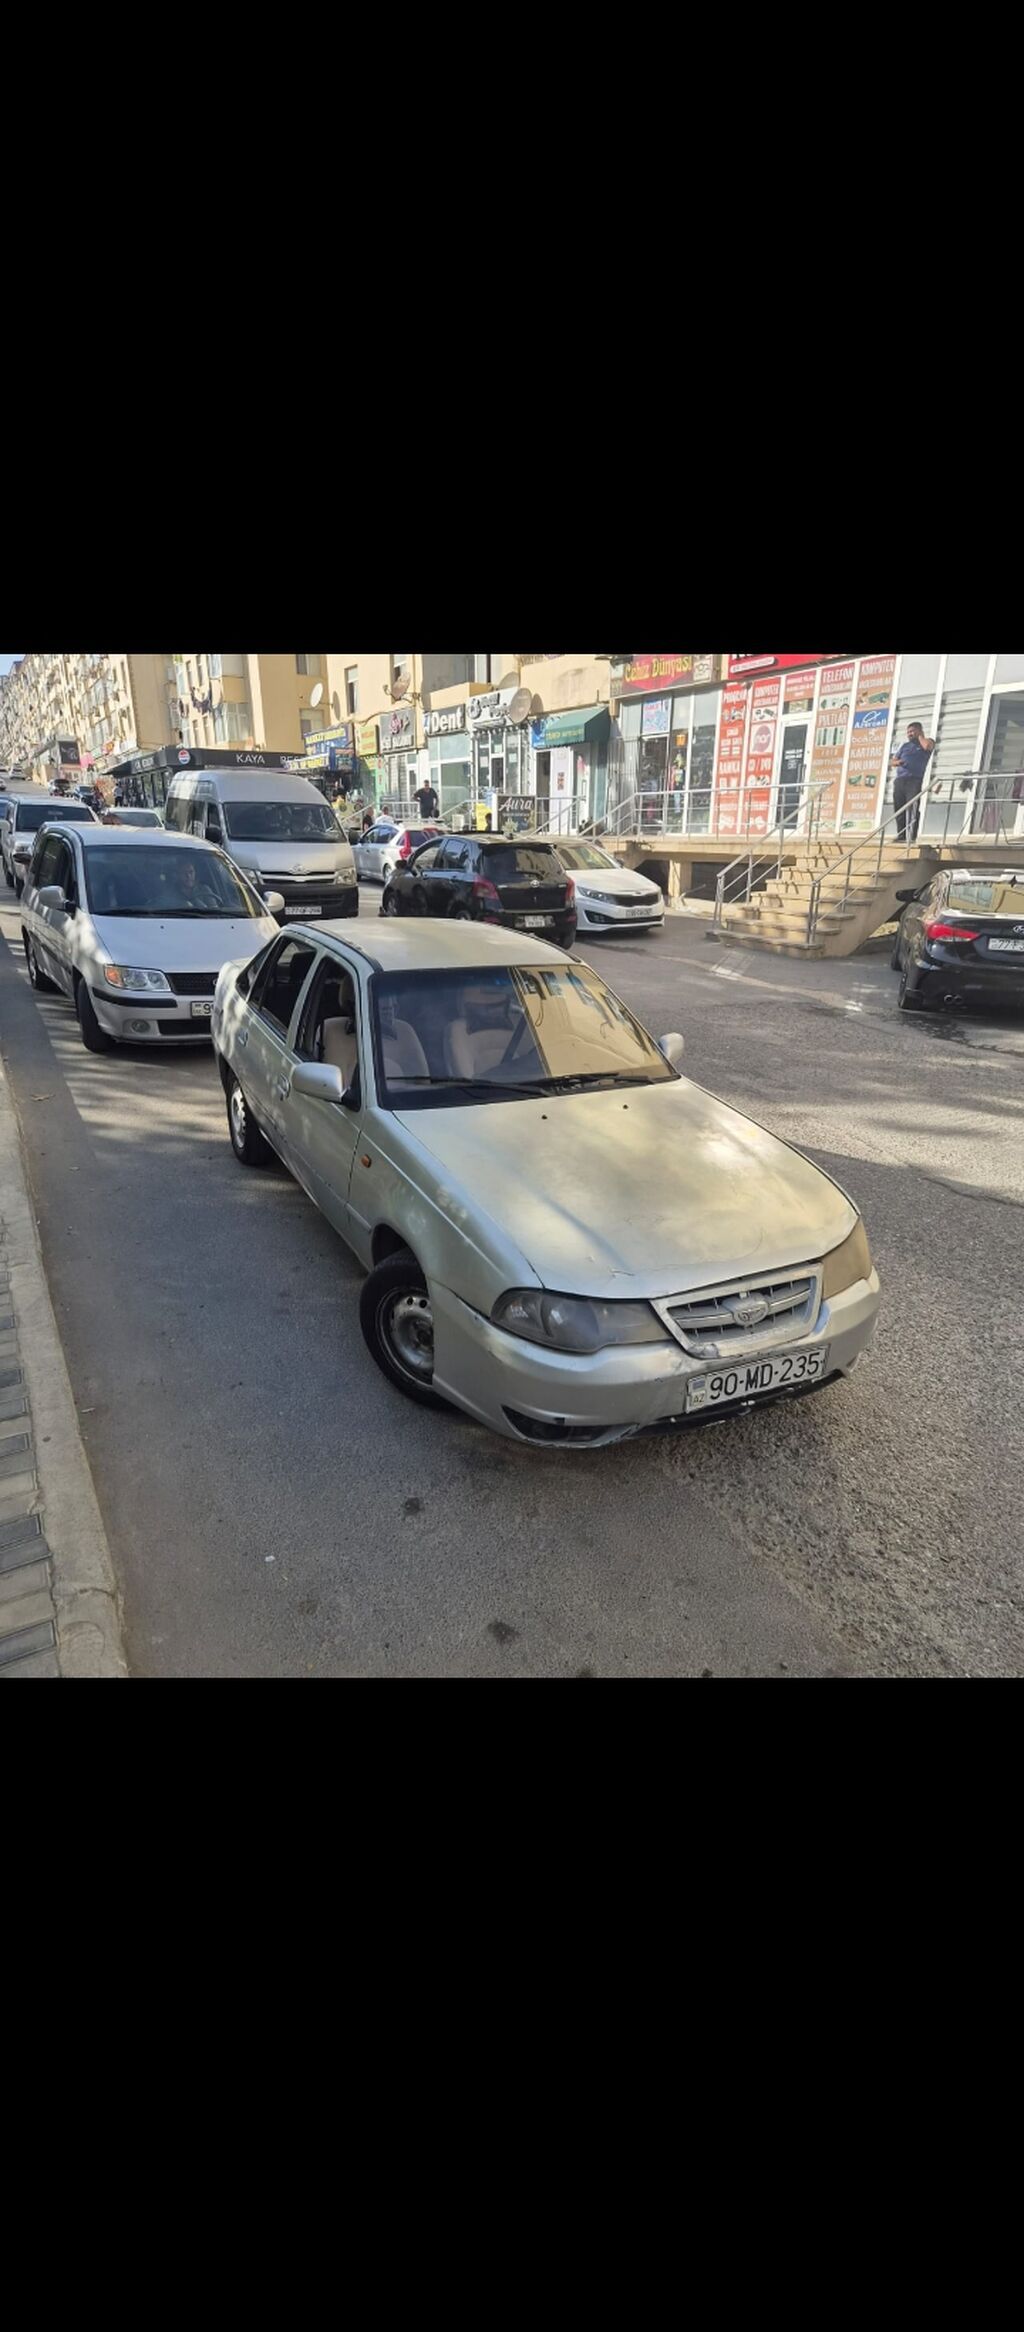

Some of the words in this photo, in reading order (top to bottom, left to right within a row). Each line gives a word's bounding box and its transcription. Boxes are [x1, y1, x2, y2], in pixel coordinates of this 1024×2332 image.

[236, 753, 266, 764] KAYA
[499, 797, 535, 811] Aura
[710, 1352, 821, 1400] 90-MD-235
